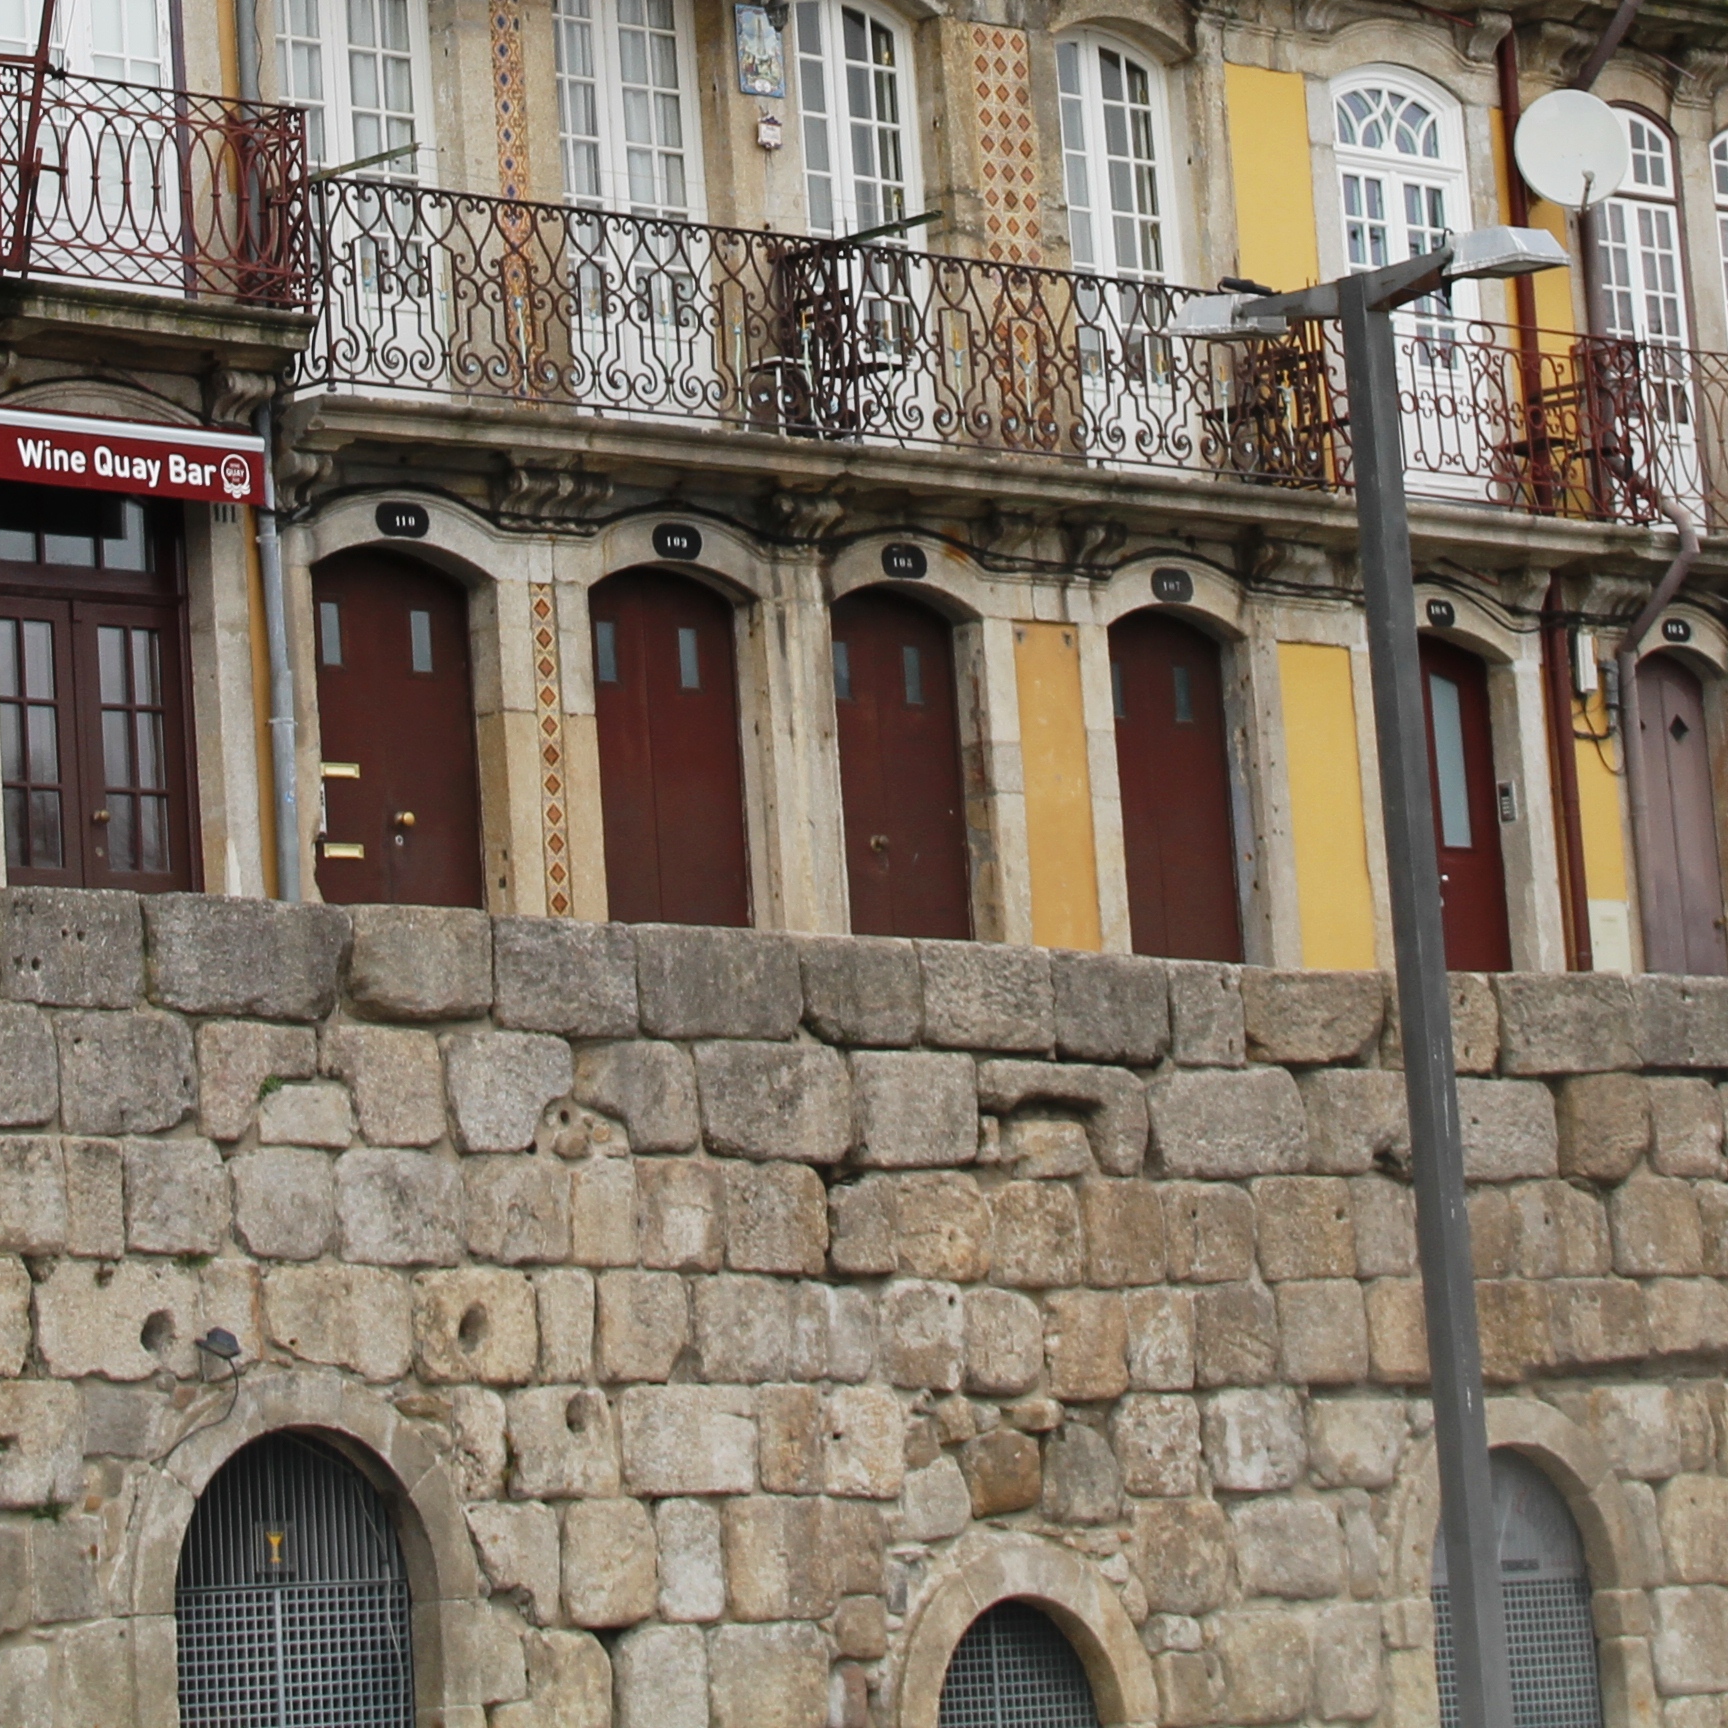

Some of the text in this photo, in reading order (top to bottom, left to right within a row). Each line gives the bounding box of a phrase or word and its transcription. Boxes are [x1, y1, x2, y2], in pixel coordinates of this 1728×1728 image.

[17, 438, 217, 488] Wine Quay Bar
[226, 468, 245, 478] QUAY
[395, 515, 415, 527] 110
[667, 536, 687, 548] 109
